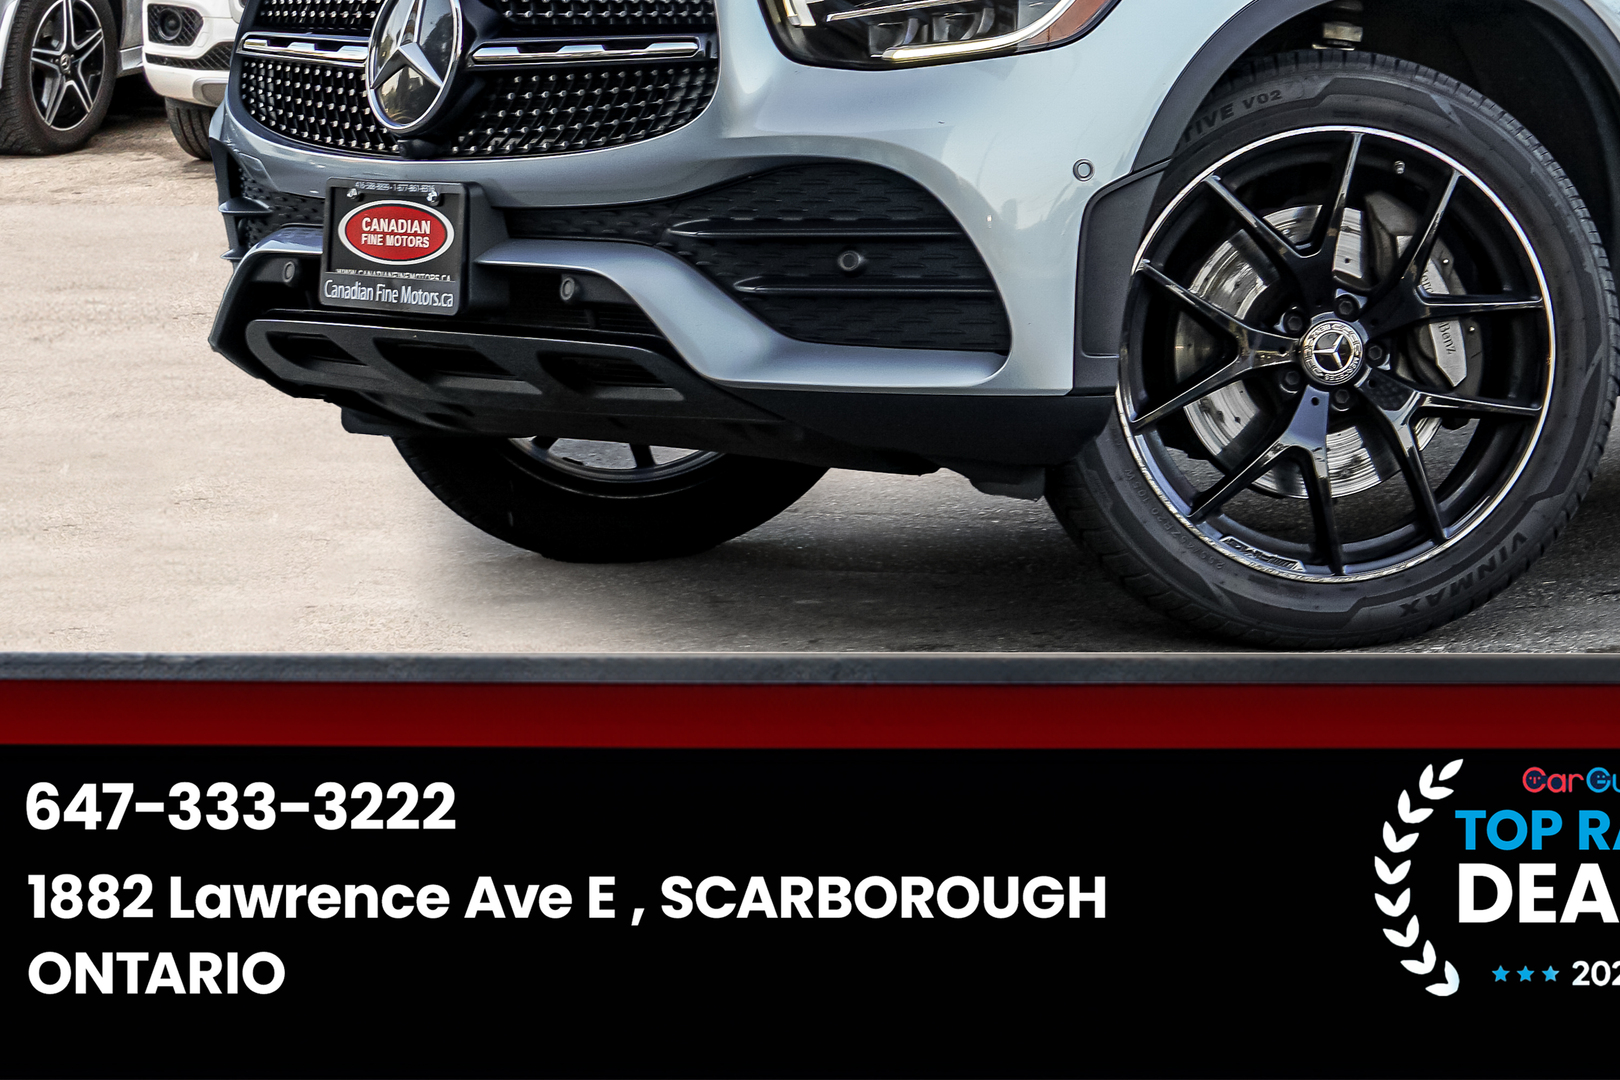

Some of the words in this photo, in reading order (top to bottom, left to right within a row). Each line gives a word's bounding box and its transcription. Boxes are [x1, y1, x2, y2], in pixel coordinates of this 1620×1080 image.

[1182, 102, 1235, 143] TIVE
[360, 233, 384, 246] FINE
[385, 235, 430, 248] MOTORS
[361, 217, 431, 235] CANADIAN
[324, 279, 374, 302] Canadian
[375, 283, 399, 303] Fine
[400, 285, 454, 308] Motors.ca
[1399, 531, 1528, 618] VINMAX
